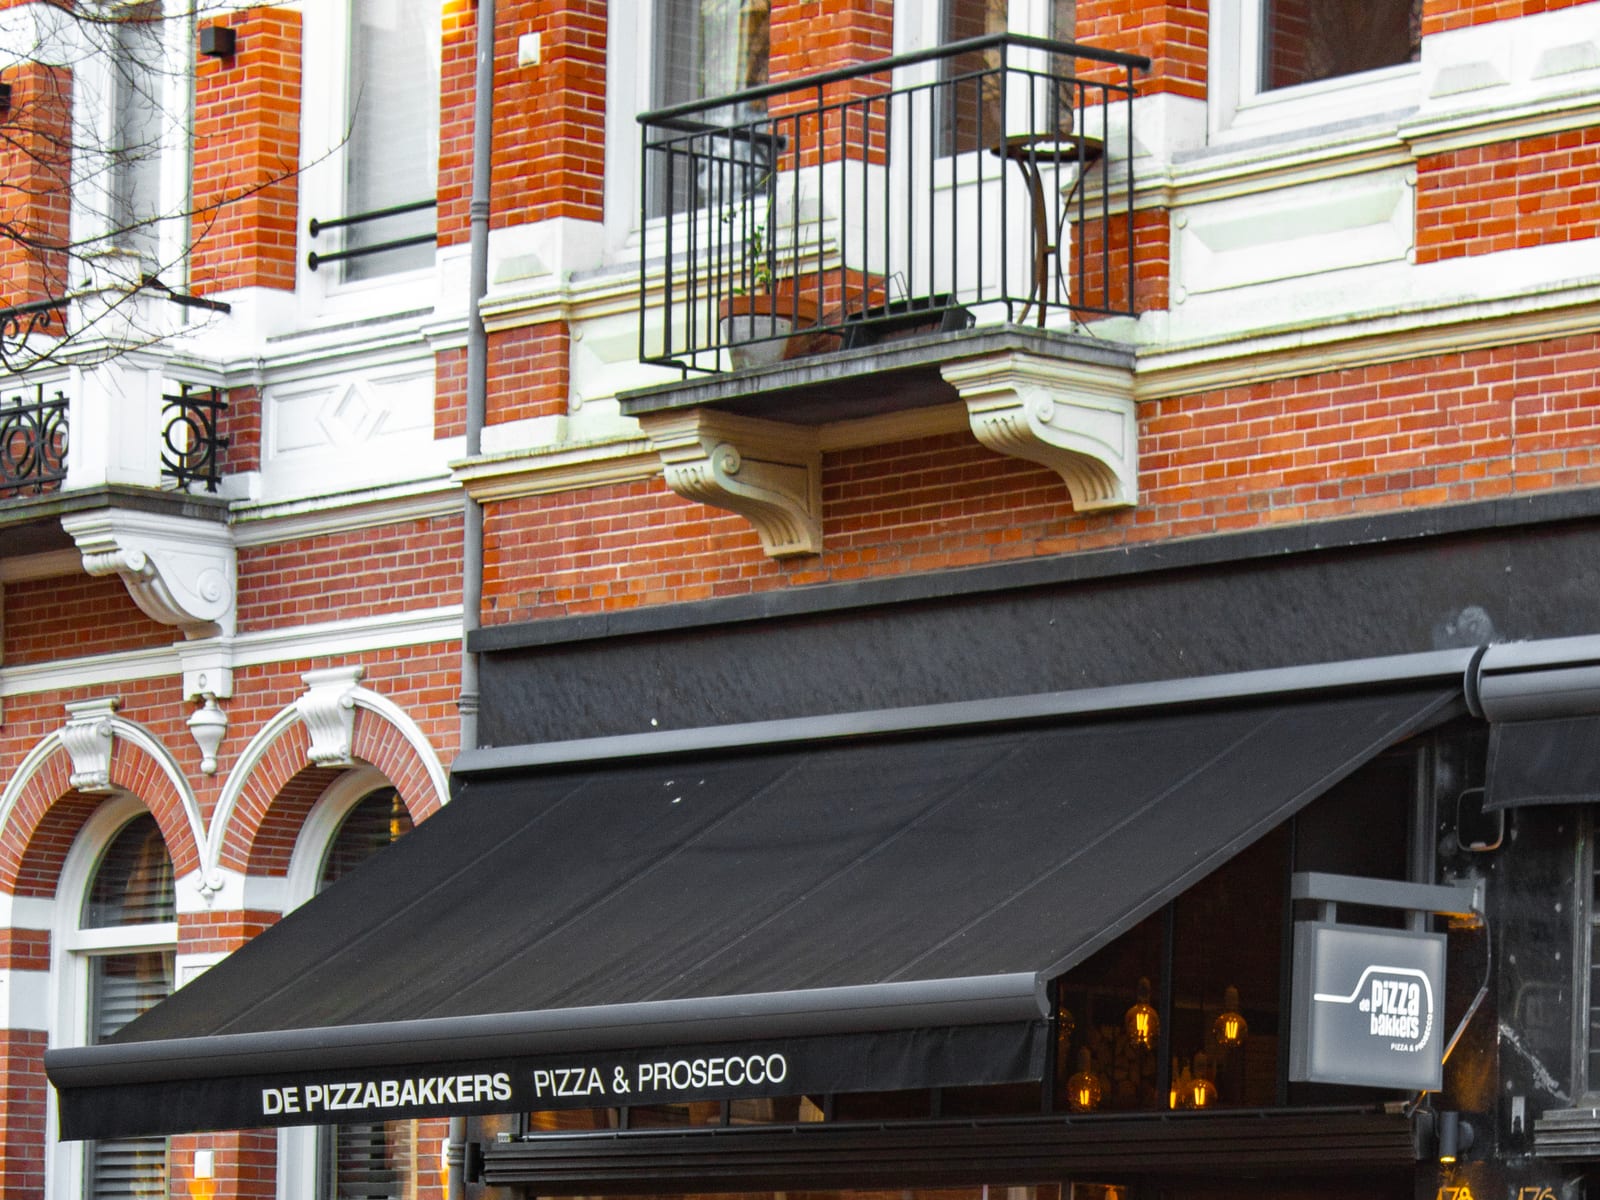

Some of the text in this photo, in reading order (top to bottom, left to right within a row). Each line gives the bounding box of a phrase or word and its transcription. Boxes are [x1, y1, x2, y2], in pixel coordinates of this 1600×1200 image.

[1370, 1013, 1419, 1039] bakkers
[1391, 1043, 1408, 1052] PIZZA
[262, 1053, 788, 1116] DE PIZZABAKKERS PIZZA & PROSECCO
